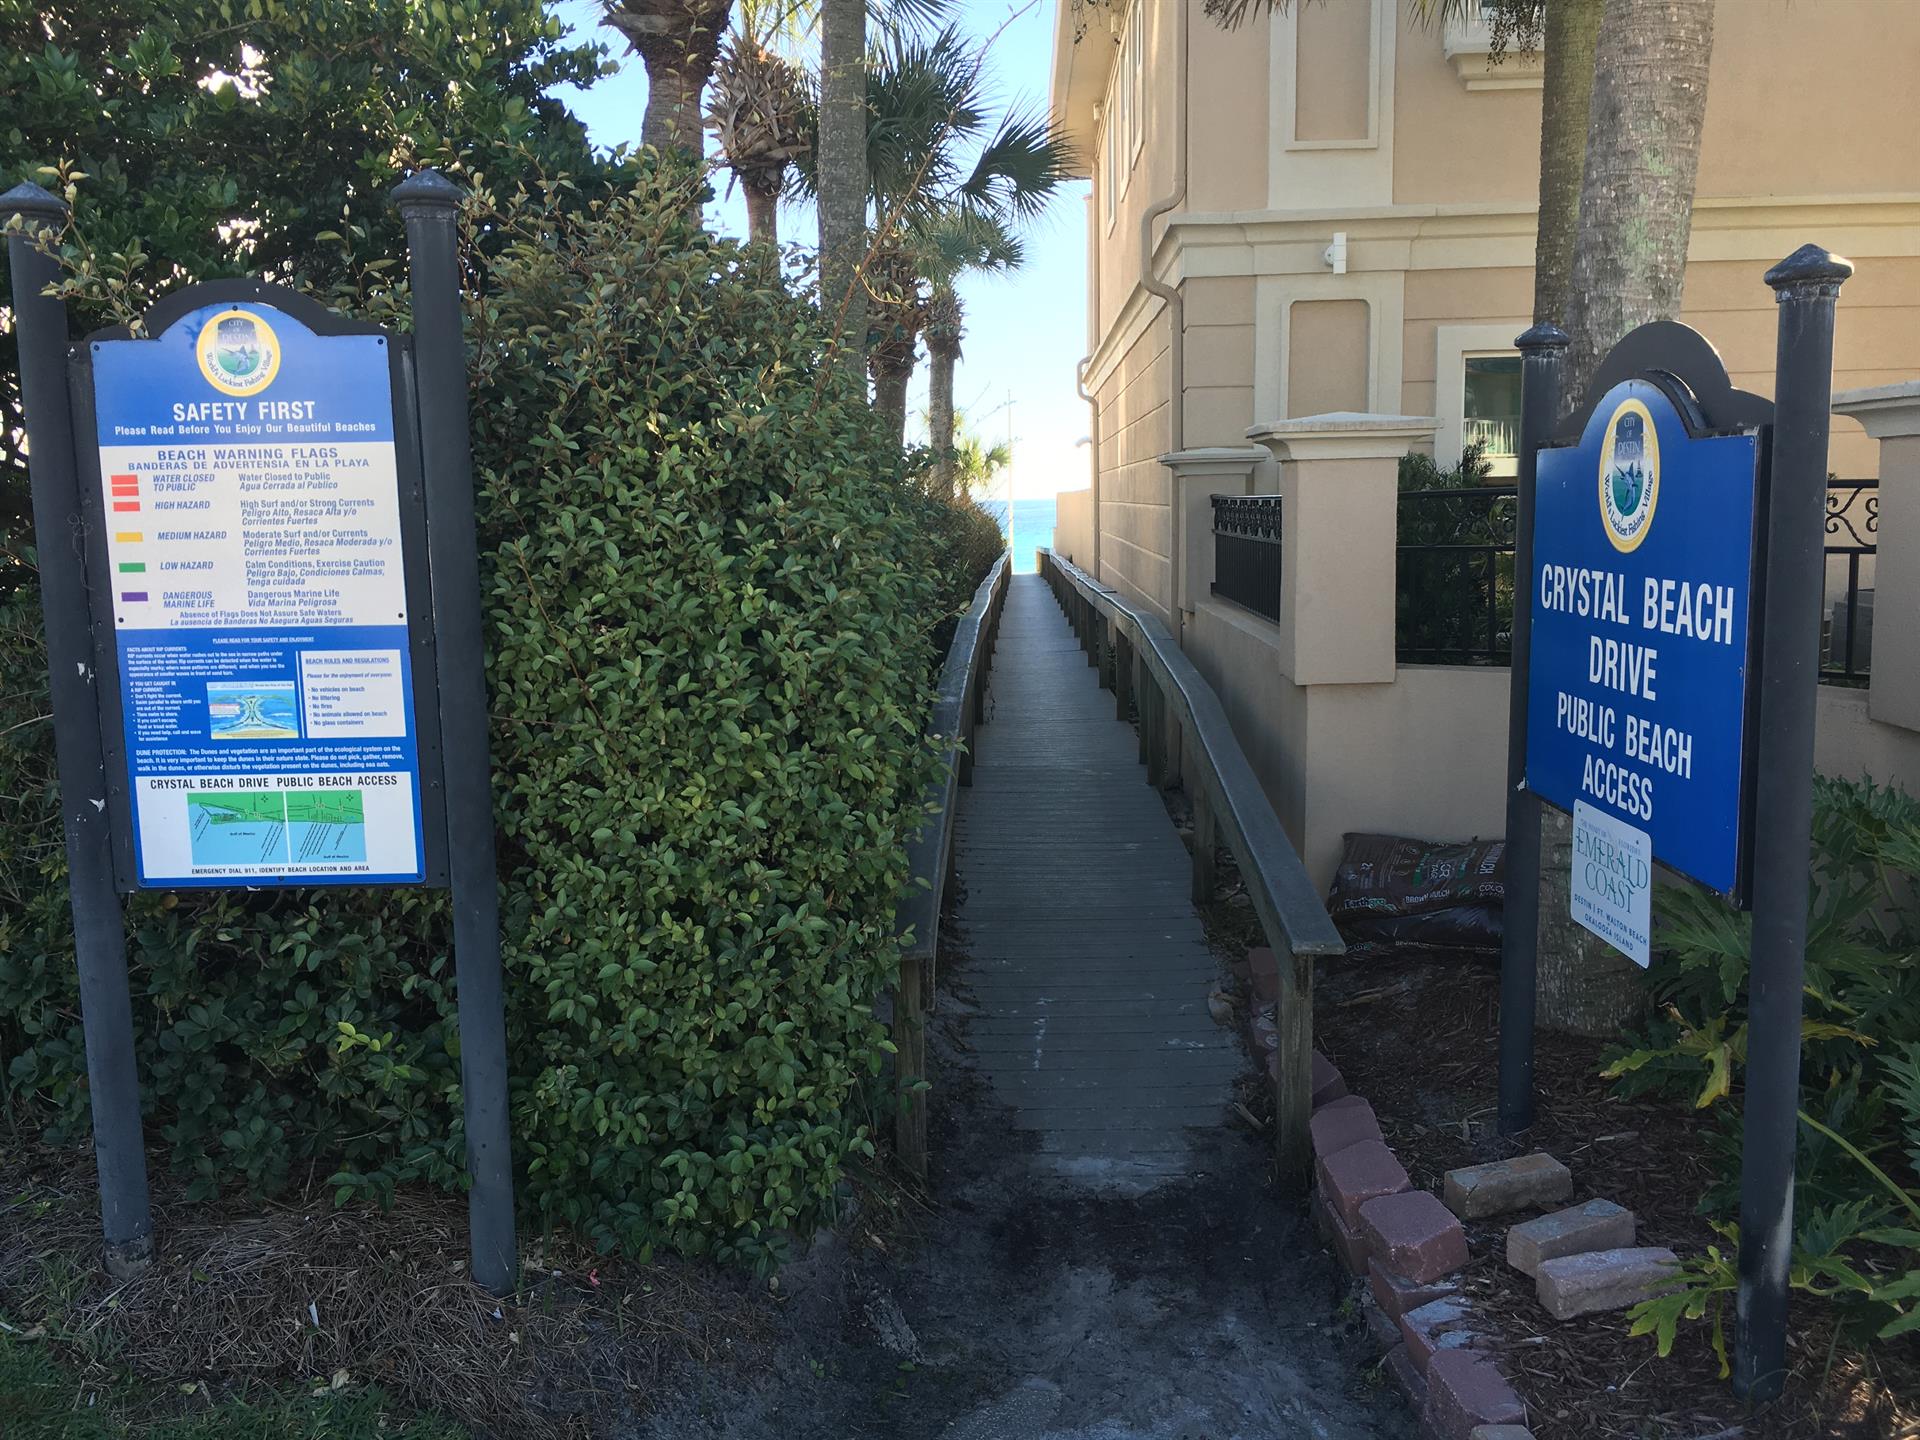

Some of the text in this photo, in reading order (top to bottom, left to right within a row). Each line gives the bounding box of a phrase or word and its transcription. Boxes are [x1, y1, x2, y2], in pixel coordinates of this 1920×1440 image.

[173, 401, 315, 421] SAFETY FIRST
[1624, 417, 1635, 428] CITY
[114, 422, 376, 435] Please Read Before You Enjoy Our Beautiful Beaches
[1627, 430, 1632, 438] OF
[1618, 440, 1640, 455] DESTIN
[157, 447, 338, 461] BEACH WARNING FLAGS
[128, 458, 369, 471] BANDERAS DE ADVERTENSIA EN LA PLAYA
[152, 473, 215, 483] WATER CLOSED
[238, 472, 331, 481] Water Closed to Public
[153, 482, 196, 492] TO PUBLIC
[239, 480, 338, 491] Agua Cerrada al Publico
[1642, 470, 1654, 508] Village
[154, 500, 210, 510] HIGH HAZARD
[240, 498, 375, 509] High Surf and/or Strong Currents
[241, 508, 271, 519] Peligro
[293, 508, 323, 518] Resaca
[324, 507, 342, 516] Alta
[343, 507, 357, 517] y/o
[241, 516, 318, 526] Corrientes Fuertes
[157, 530, 227, 540] MEDIUM HAZARD
[242, 529, 368, 539] Moderate Surf and/or Currents
[243, 538, 273, 549] Peligro
[303, 538, 334, 548] Resaca
[335, 537, 377, 546] Moderada
[379, 537, 393, 547] y/o
[244, 547, 320, 556] Corrientes Fuertes
[160, 561, 214, 570] LOW HAZARD
[245, 560, 266, 569] Calm
[316, 559, 352, 569] Exercise
[353, 559, 385, 569] Caution
[246, 569, 275, 579] Peligro
[299, 568, 350, 577] Condiciones
[247, 577, 306, 587] Tenga cuidada
[162, 591, 212, 600] DANGEROUS
[247, 588, 340, 600] Dangerous Marine Life
[163, 599, 215, 608] MARINE LIFE
[248, 598, 337, 608] Vida Marina Peligrosa
[1541, 563, 1733, 645] CRYSTAL BEACH
[210, 610, 218, 618] of
[219, 610, 239, 618] Flags
[259, 610, 272, 618] Not
[299, 609, 315, 618] Safe
[316, 609, 342, 617] Waters
[269, 617, 299, 625] Asegura
[300, 617, 323, 625] Aguas
[1589, 636, 1657, 701] DRIVE
[1557, 691, 1692, 779] PUBLIC BEACH
[150, 775, 397, 790] CRYSTAL BEACH DRIVE PUBLIC BEACH ACCESS
[1582, 755, 1652, 820] ACCESS
[1575, 827, 1648, 889] EMERALD
[1584, 863, 1634, 912] COAST
